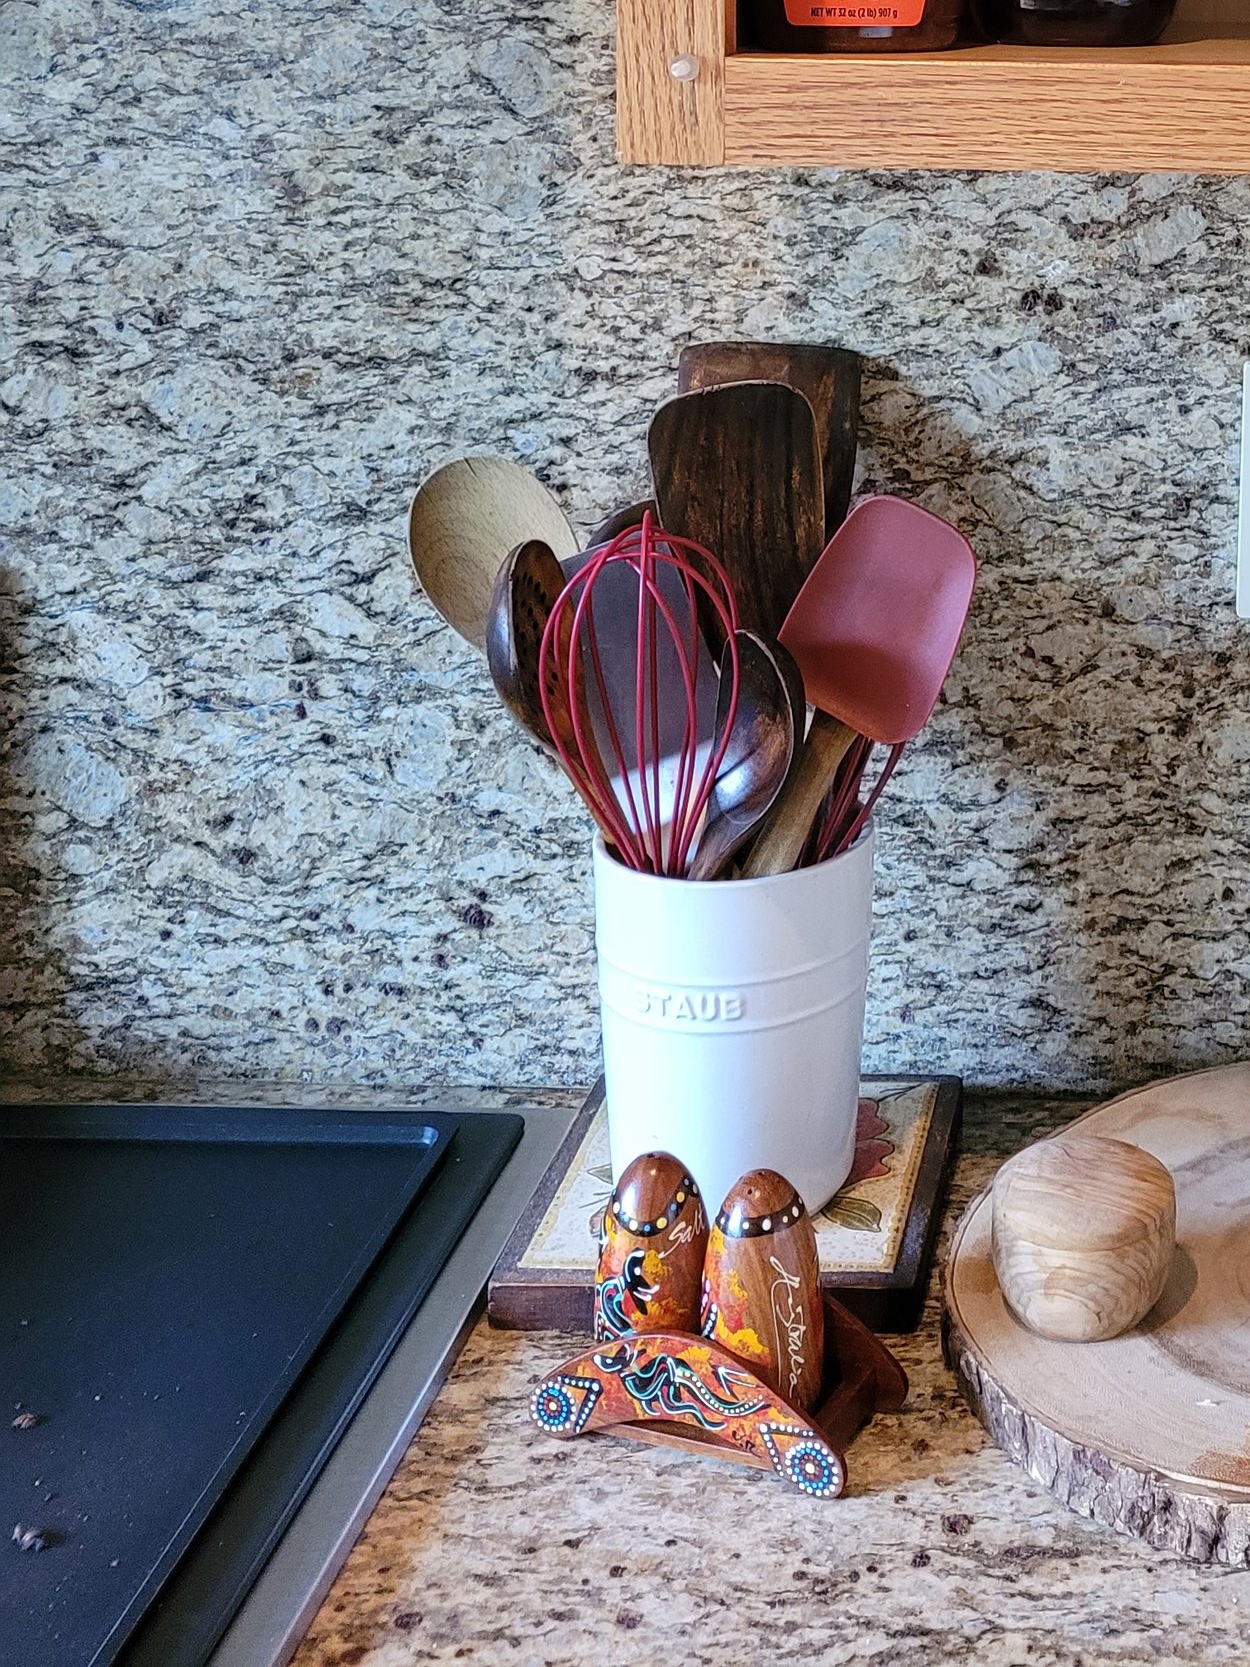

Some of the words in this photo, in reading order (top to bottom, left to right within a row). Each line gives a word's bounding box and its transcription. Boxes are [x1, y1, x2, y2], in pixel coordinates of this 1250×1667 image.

[811, 7, 824, 17] NET
[825, 7, 837, 17] WT
[848, 9, 857, 17] oz
[866, 7, 877, 18] lb)
[878, 7, 891, 18] 907
[892, 9, 898, 19] g
[636, 990, 747, 1022] STAUB
[658, 1207, 706, 1260] Salt
[770, 1255, 806, 1398] Australia
